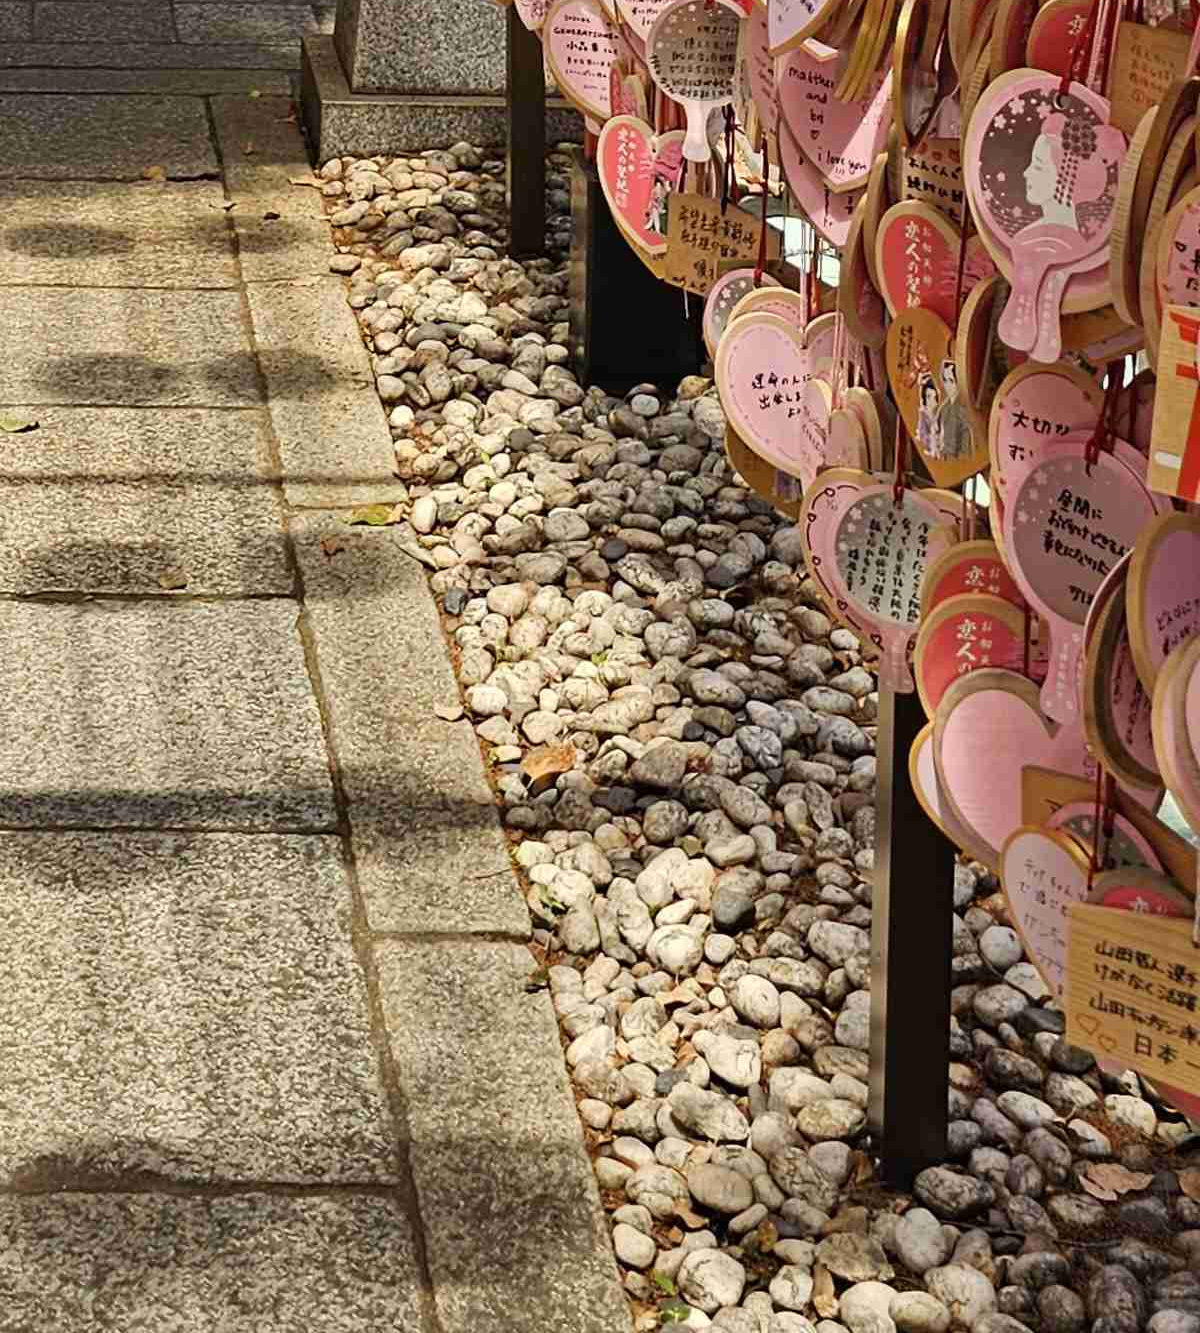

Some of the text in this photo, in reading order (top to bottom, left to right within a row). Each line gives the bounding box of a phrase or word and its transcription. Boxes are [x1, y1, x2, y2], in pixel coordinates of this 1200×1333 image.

[805, 92, 828, 104] and
[826, 149, 846, 165] love
[1057, 488, 1104, 520] 昼間に
